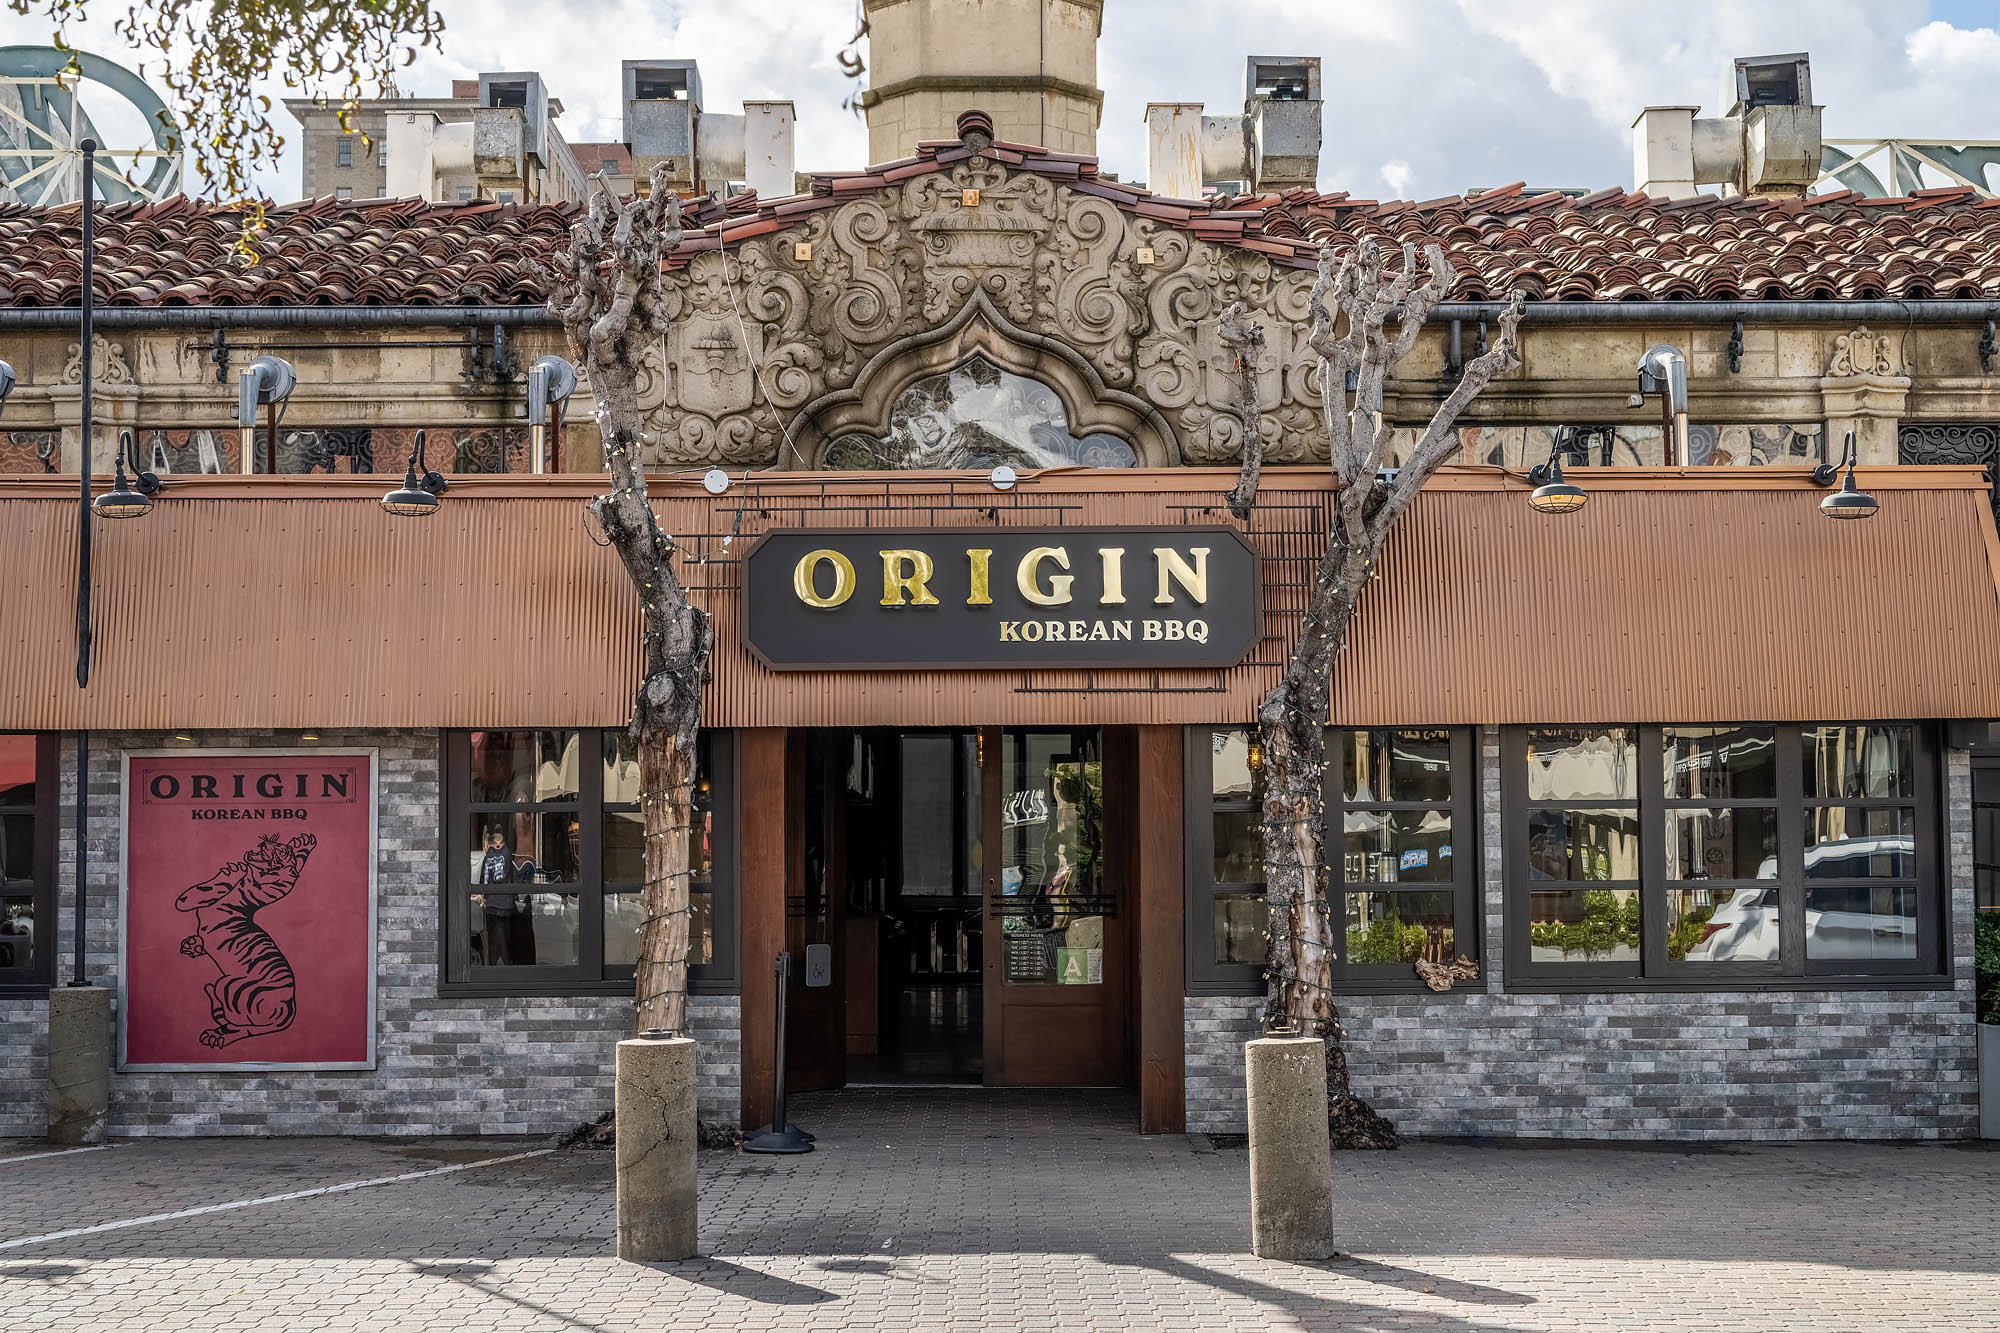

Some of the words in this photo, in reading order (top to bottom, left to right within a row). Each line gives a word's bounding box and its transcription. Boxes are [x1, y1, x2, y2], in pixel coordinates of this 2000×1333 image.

[793, 547, 1211, 608] ORIGIN
[999, 619, 1133, 642] KOREAN
[1141, 618, 1209, 645] BBQ
[149, 773, 350, 799] ORIGIN
[191, 808, 265, 820] KOREAN
[271, 808, 308, 821] BBQ
[1063, 955, 1082, 977] A
